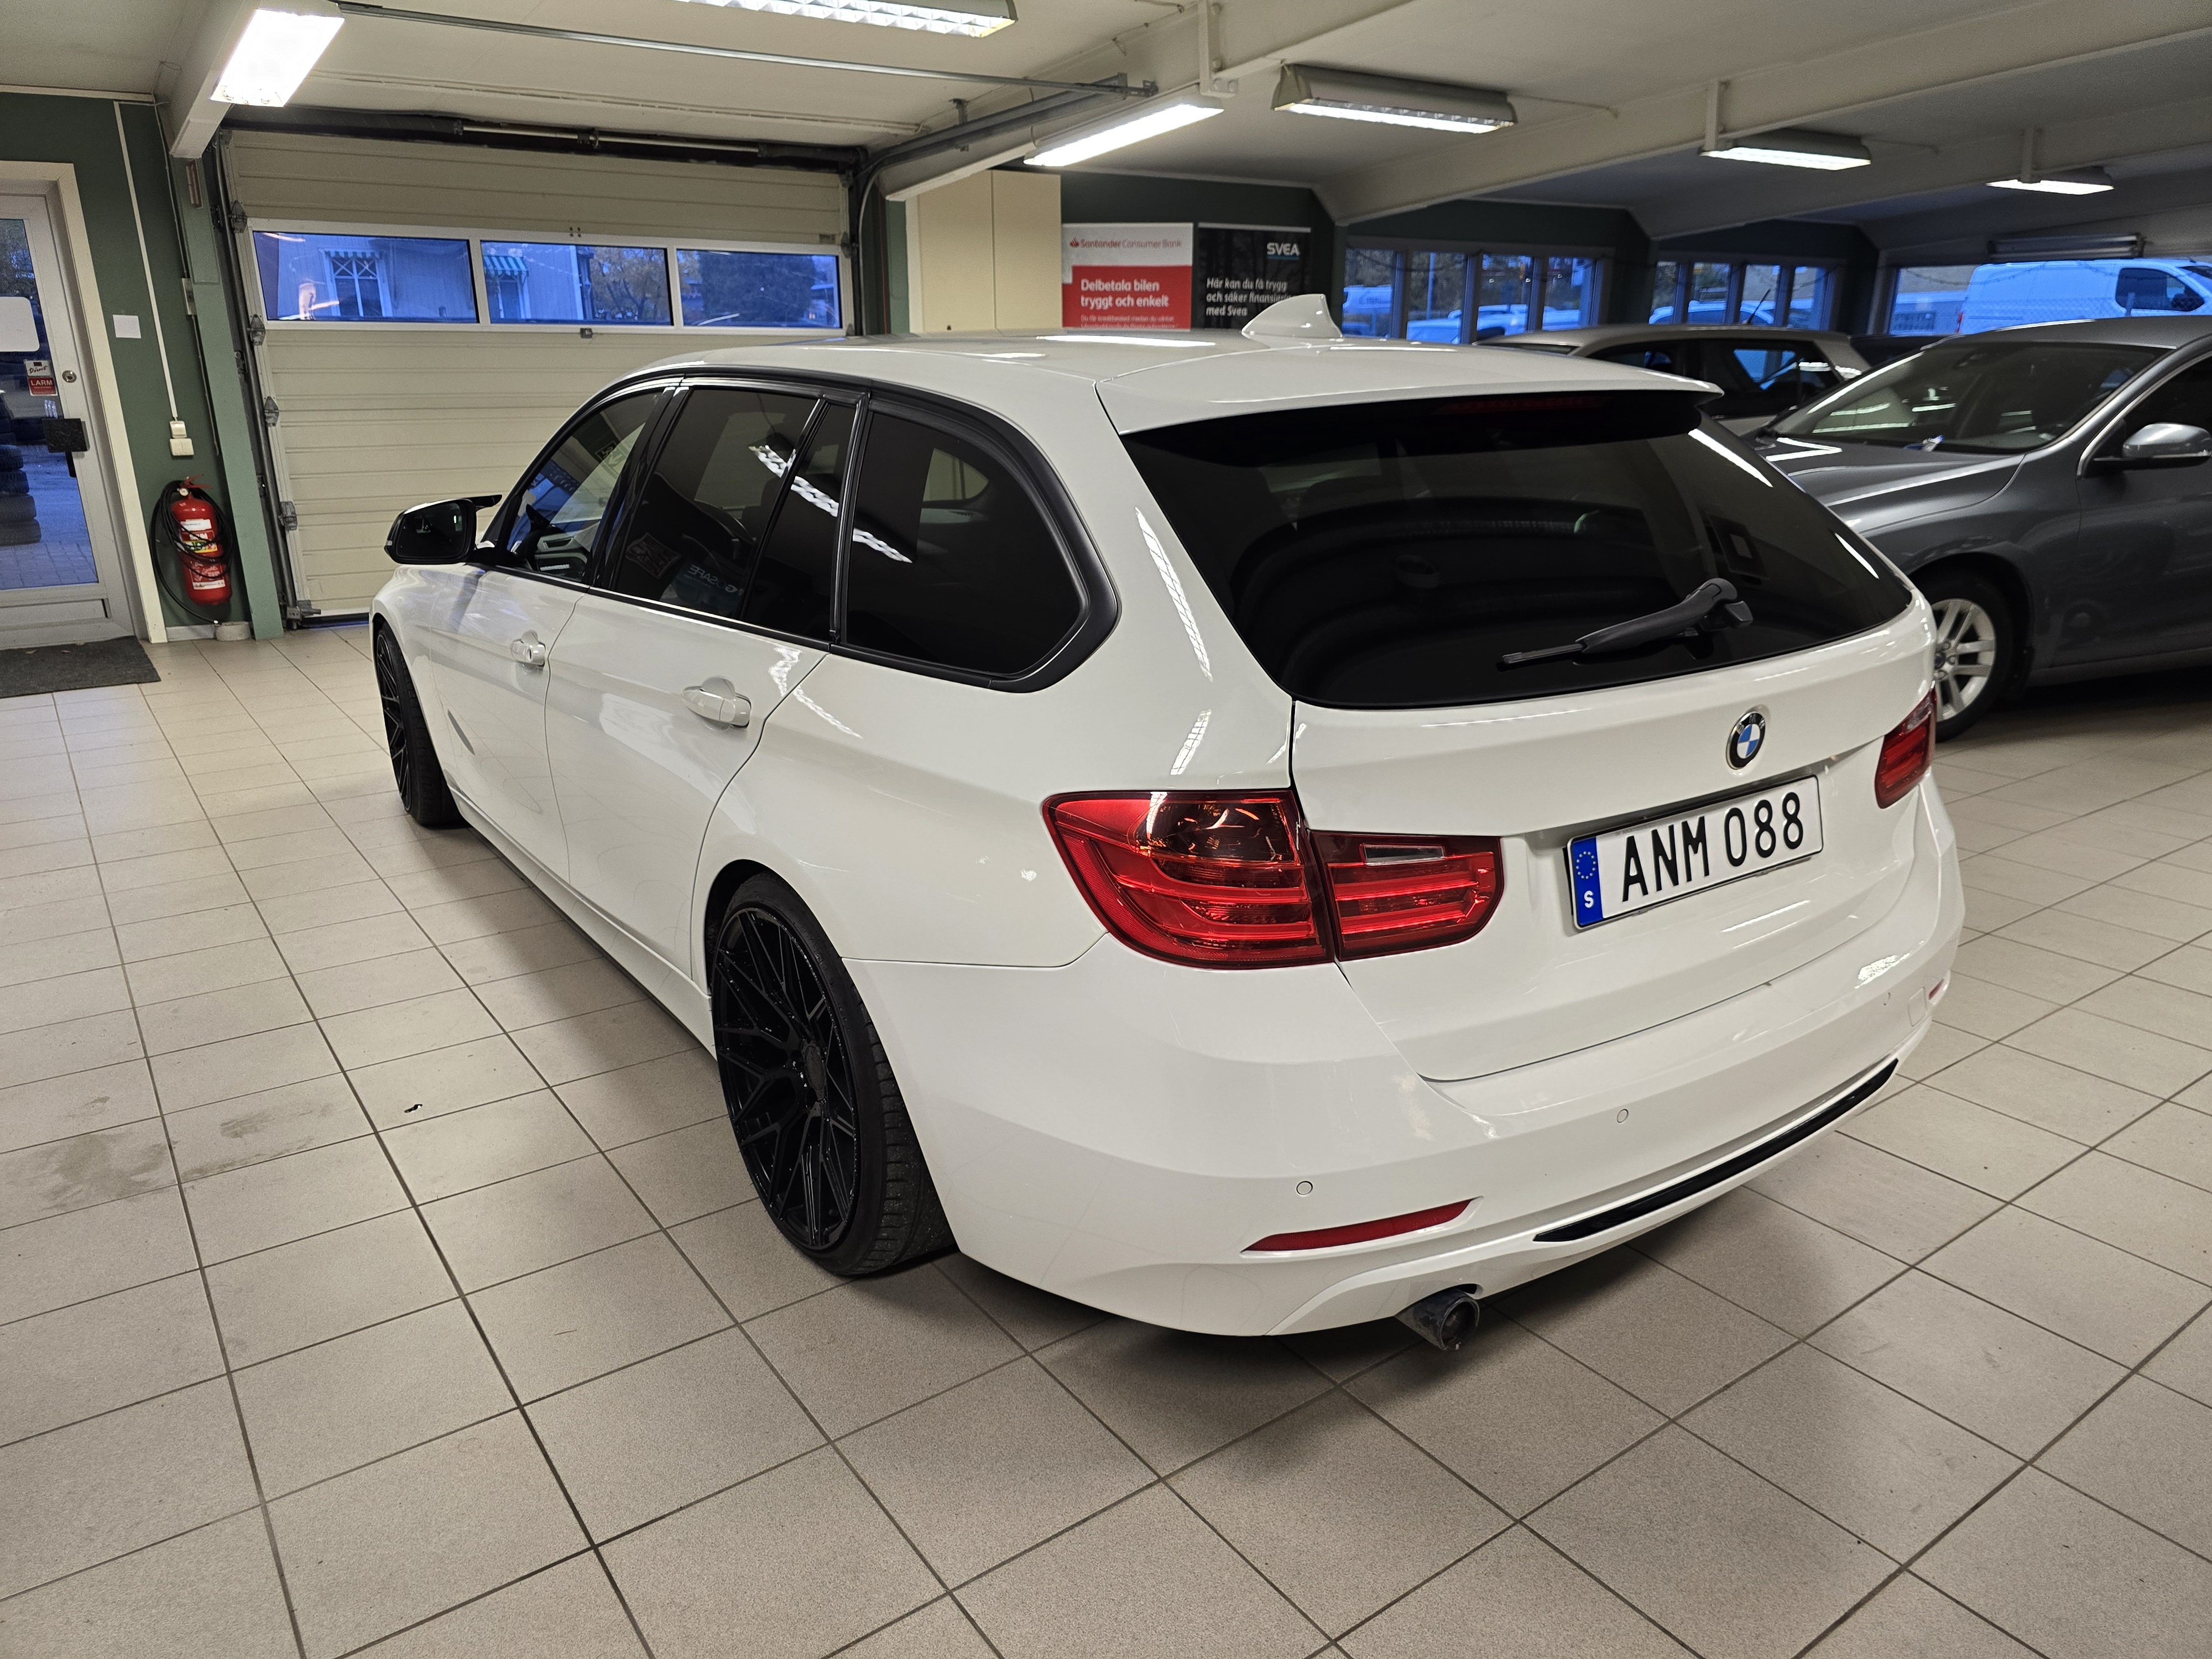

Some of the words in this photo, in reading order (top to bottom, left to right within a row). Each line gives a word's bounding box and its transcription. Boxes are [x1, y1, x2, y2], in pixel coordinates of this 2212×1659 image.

[1081, 238, 1121, 248] Santander
[1122, 239, 1161, 248] Consumer
[1162, 238, 1181, 248] Bank
[1267, 242, 1300, 256] SVEA
[1081, 278, 1131, 291] Delbetala
[1134, 278, 1160, 291] bilen
[1207, 277, 1223, 289] Här
[1224, 277, 1241, 289] kan
[1242, 277, 1254, 290] du
[1255, 278, 1264, 290] få
[1266, 279, 1288, 293] trygg
[1081, 295, 1113, 310] tryggt
[1115, 294, 1134, 307] och
[1136, 294, 1169, 307] enkelt
[1206, 290, 1223, 302] och
[1224, 291, 1248, 303] säker
[1206, 304, 1226, 316] med
[1227, 305, 1248, 316] Svea
[1736, 713, 1765, 734] BMW
[1622, 816, 1710, 902] ANM
[1724, 791, 1804, 867] 088
[1584, 890, 1593, 908] S
